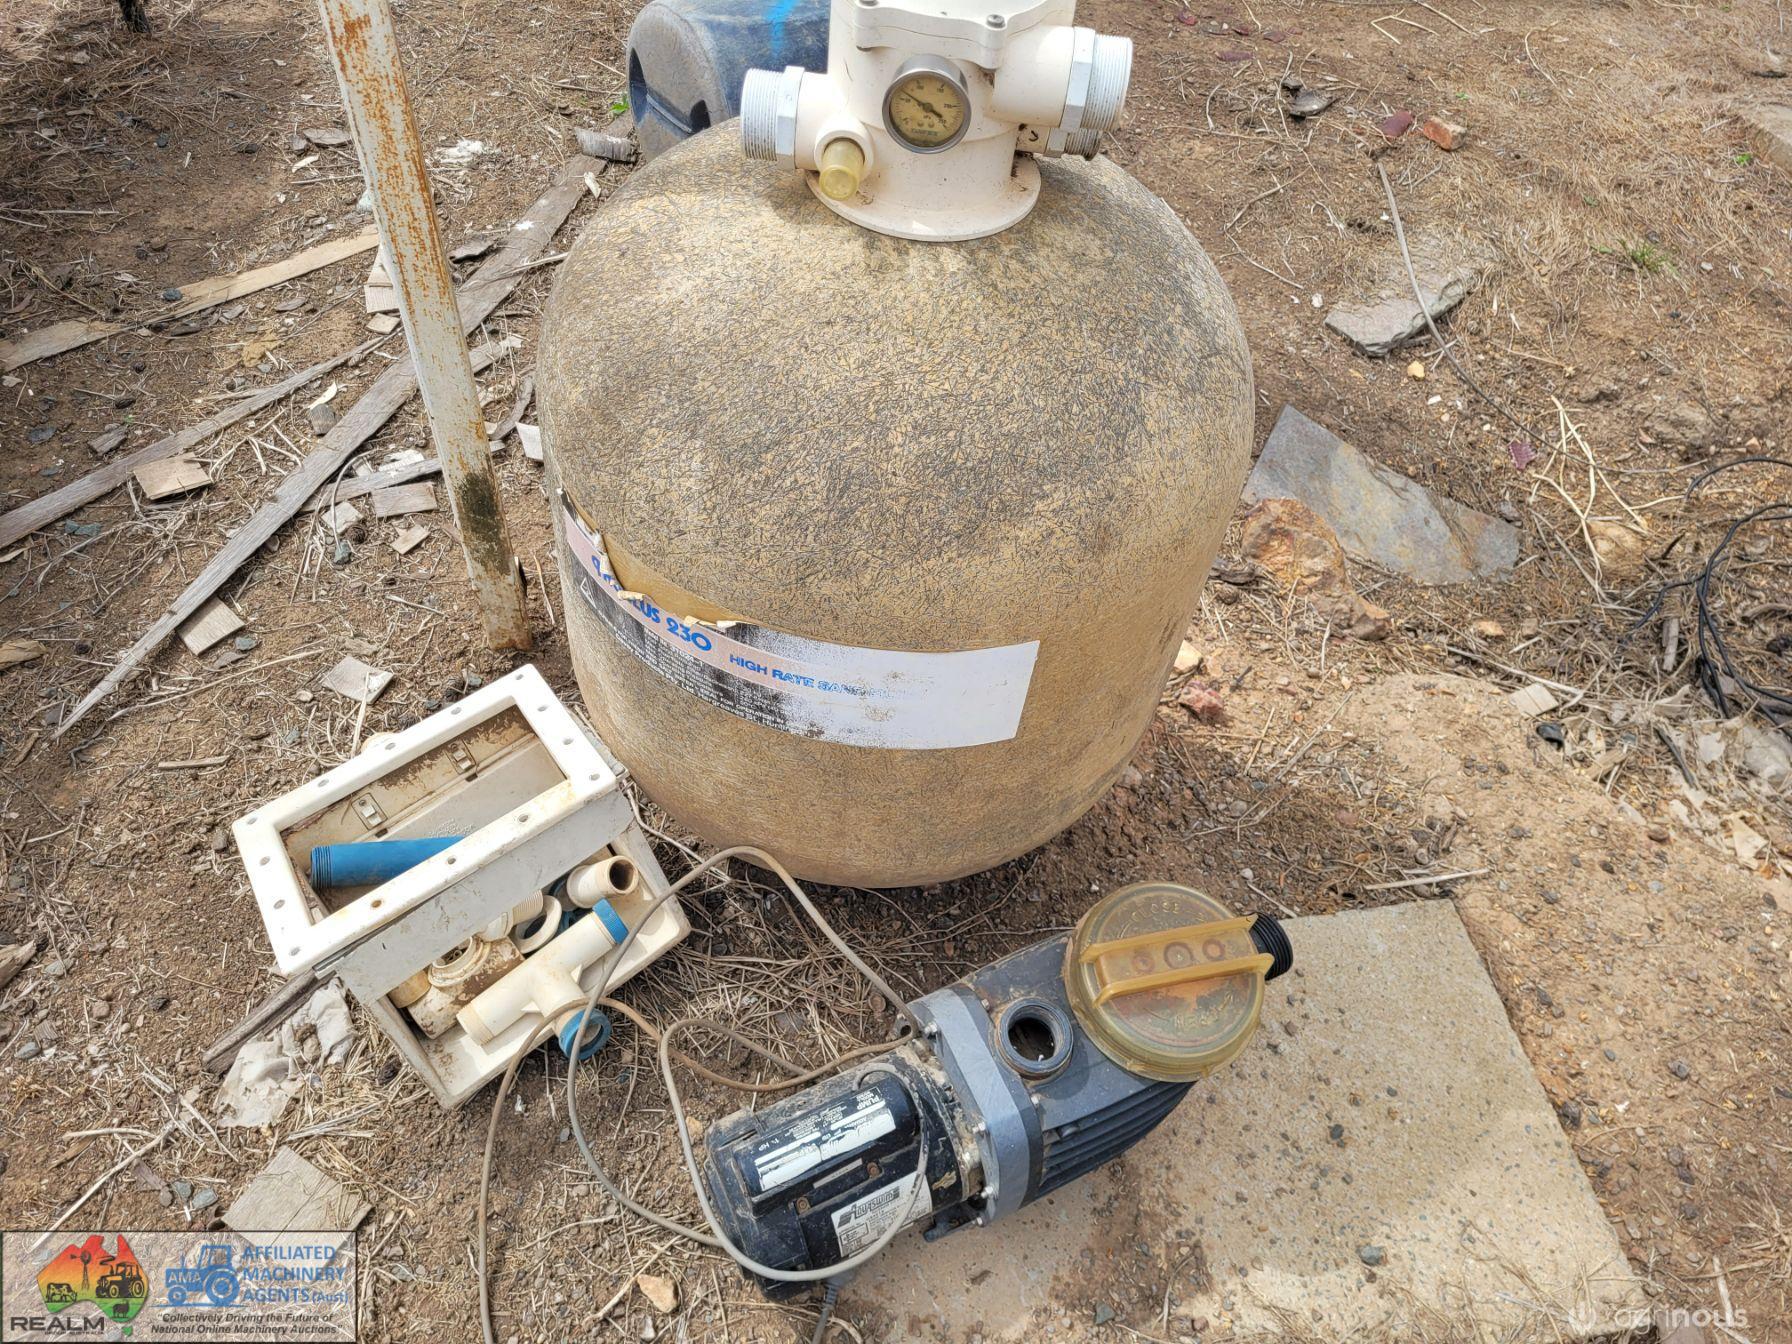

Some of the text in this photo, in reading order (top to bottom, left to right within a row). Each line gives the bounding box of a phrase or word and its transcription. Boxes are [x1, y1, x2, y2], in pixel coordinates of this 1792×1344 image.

[666, 617, 712, 651] 230
[729, 654, 768, 675] HIGH
[772, 669, 814, 690] RATE
[857, 1095, 880, 1110] PUMP
[758, 1142, 770, 1152] HP
